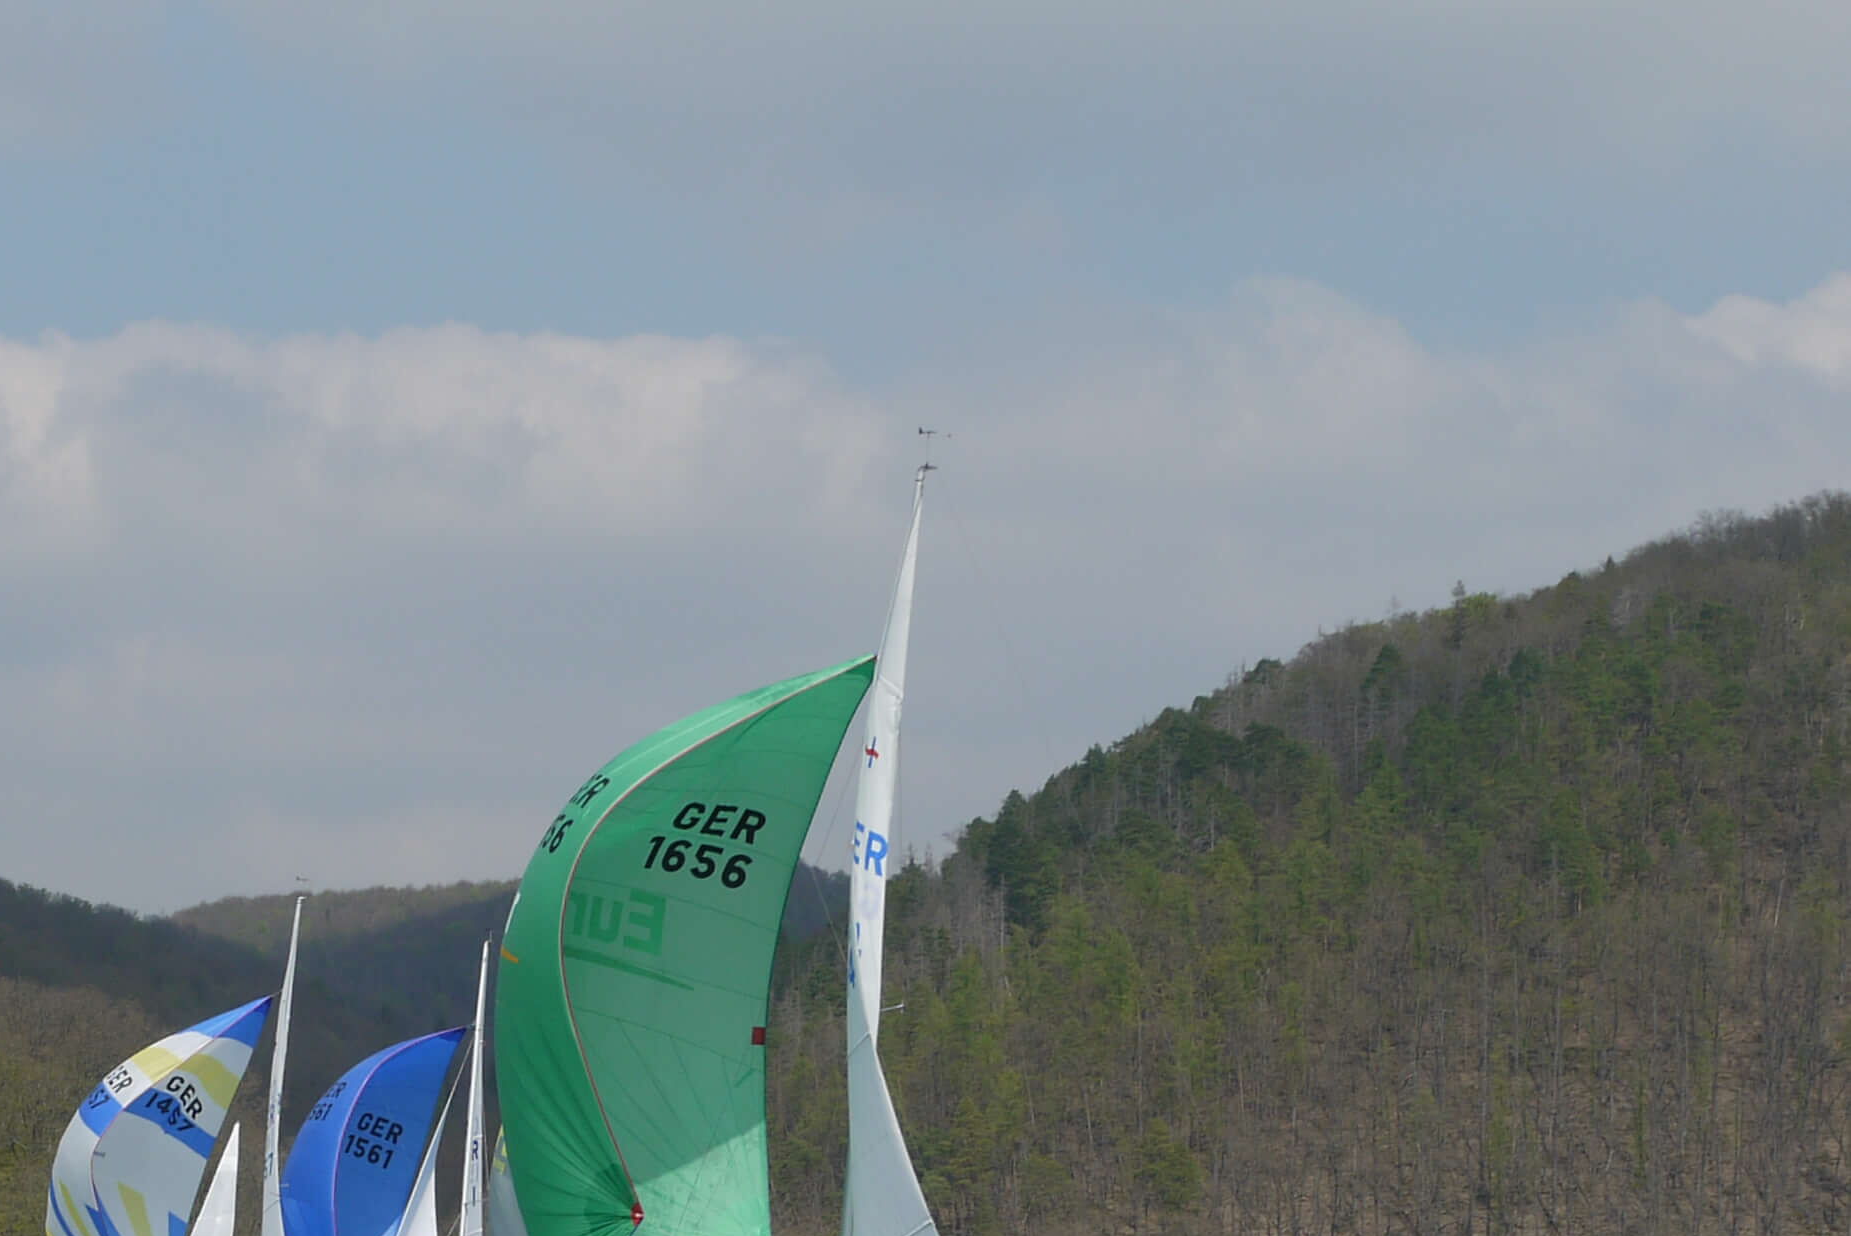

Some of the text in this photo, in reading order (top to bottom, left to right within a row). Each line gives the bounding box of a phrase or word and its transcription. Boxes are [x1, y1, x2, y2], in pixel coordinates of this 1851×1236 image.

[672, 802, 767, 845] GER
[643, 836, 754, 889] 1656
[145, 1092, 196, 1132] 1457
[166, 1076, 203, 1120] GER
[357, 1113, 403, 1145] GER
[344, 1135, 395, 1169] 1561
